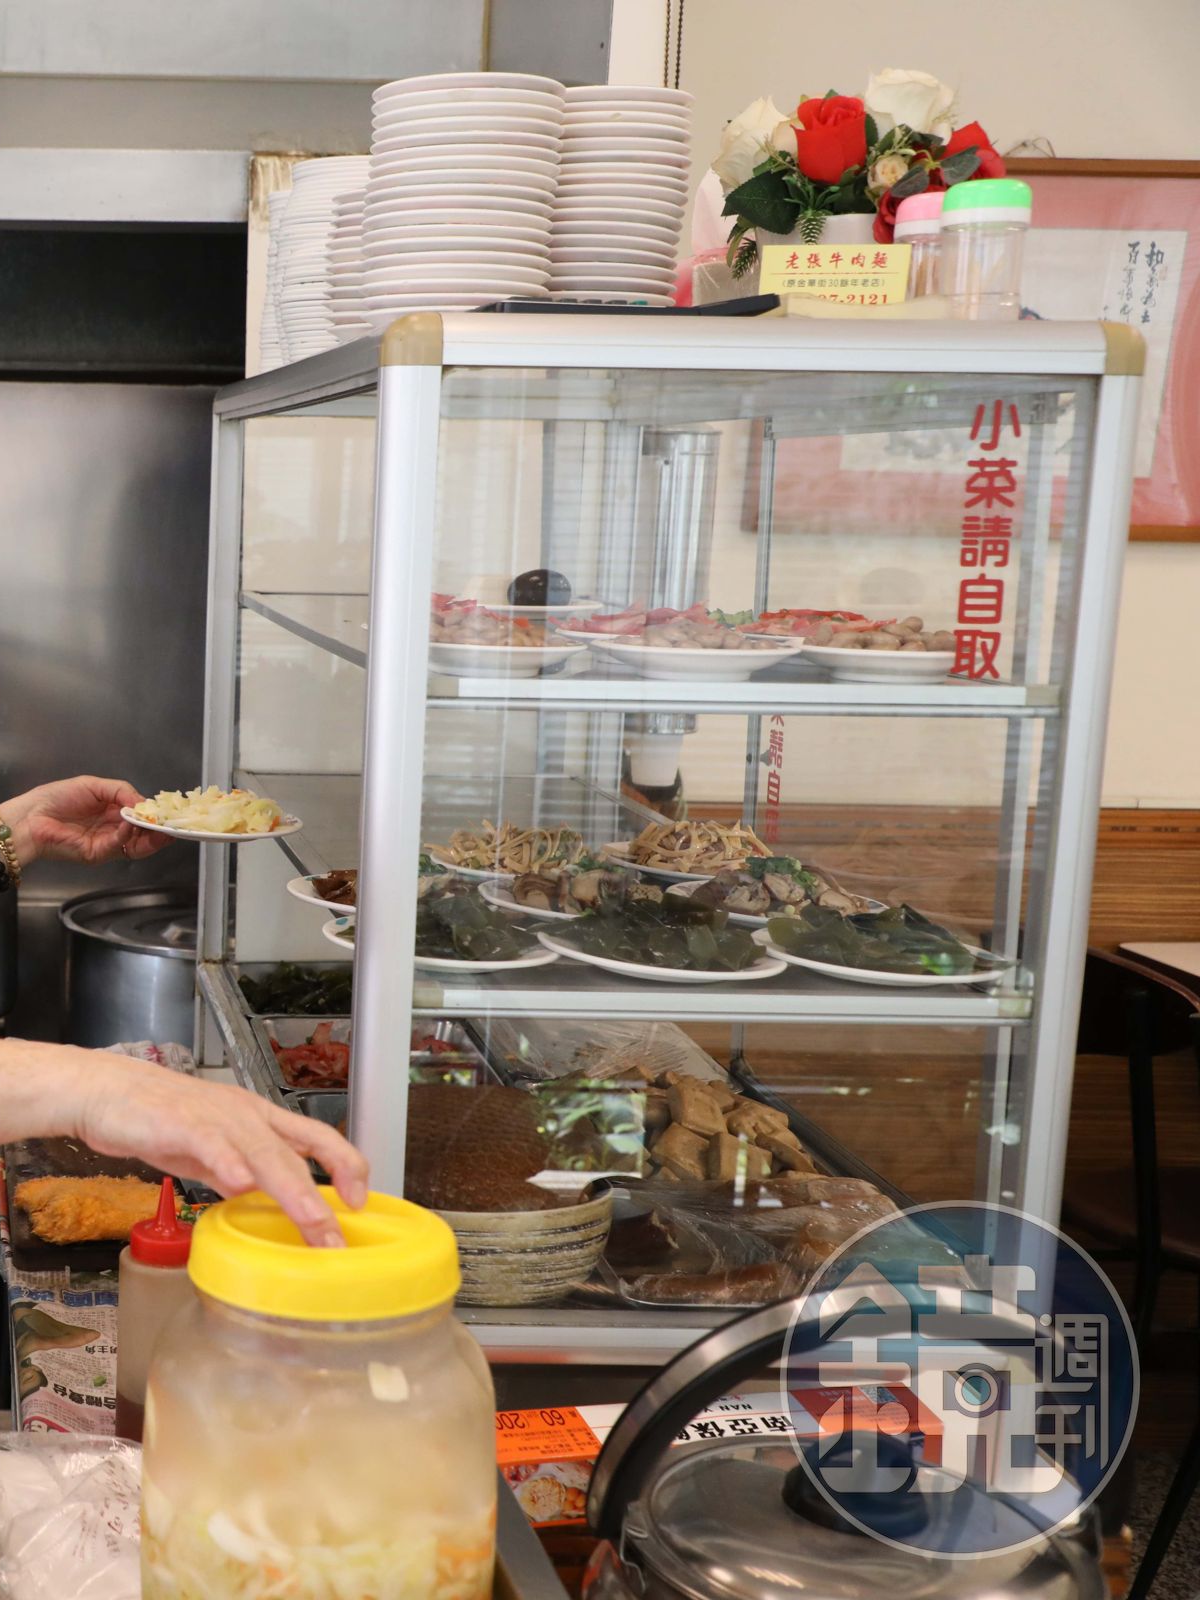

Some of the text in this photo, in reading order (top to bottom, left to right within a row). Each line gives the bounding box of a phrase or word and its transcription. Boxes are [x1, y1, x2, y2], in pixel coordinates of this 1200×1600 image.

[950, 399, 1022, 680] 小菜請自取
